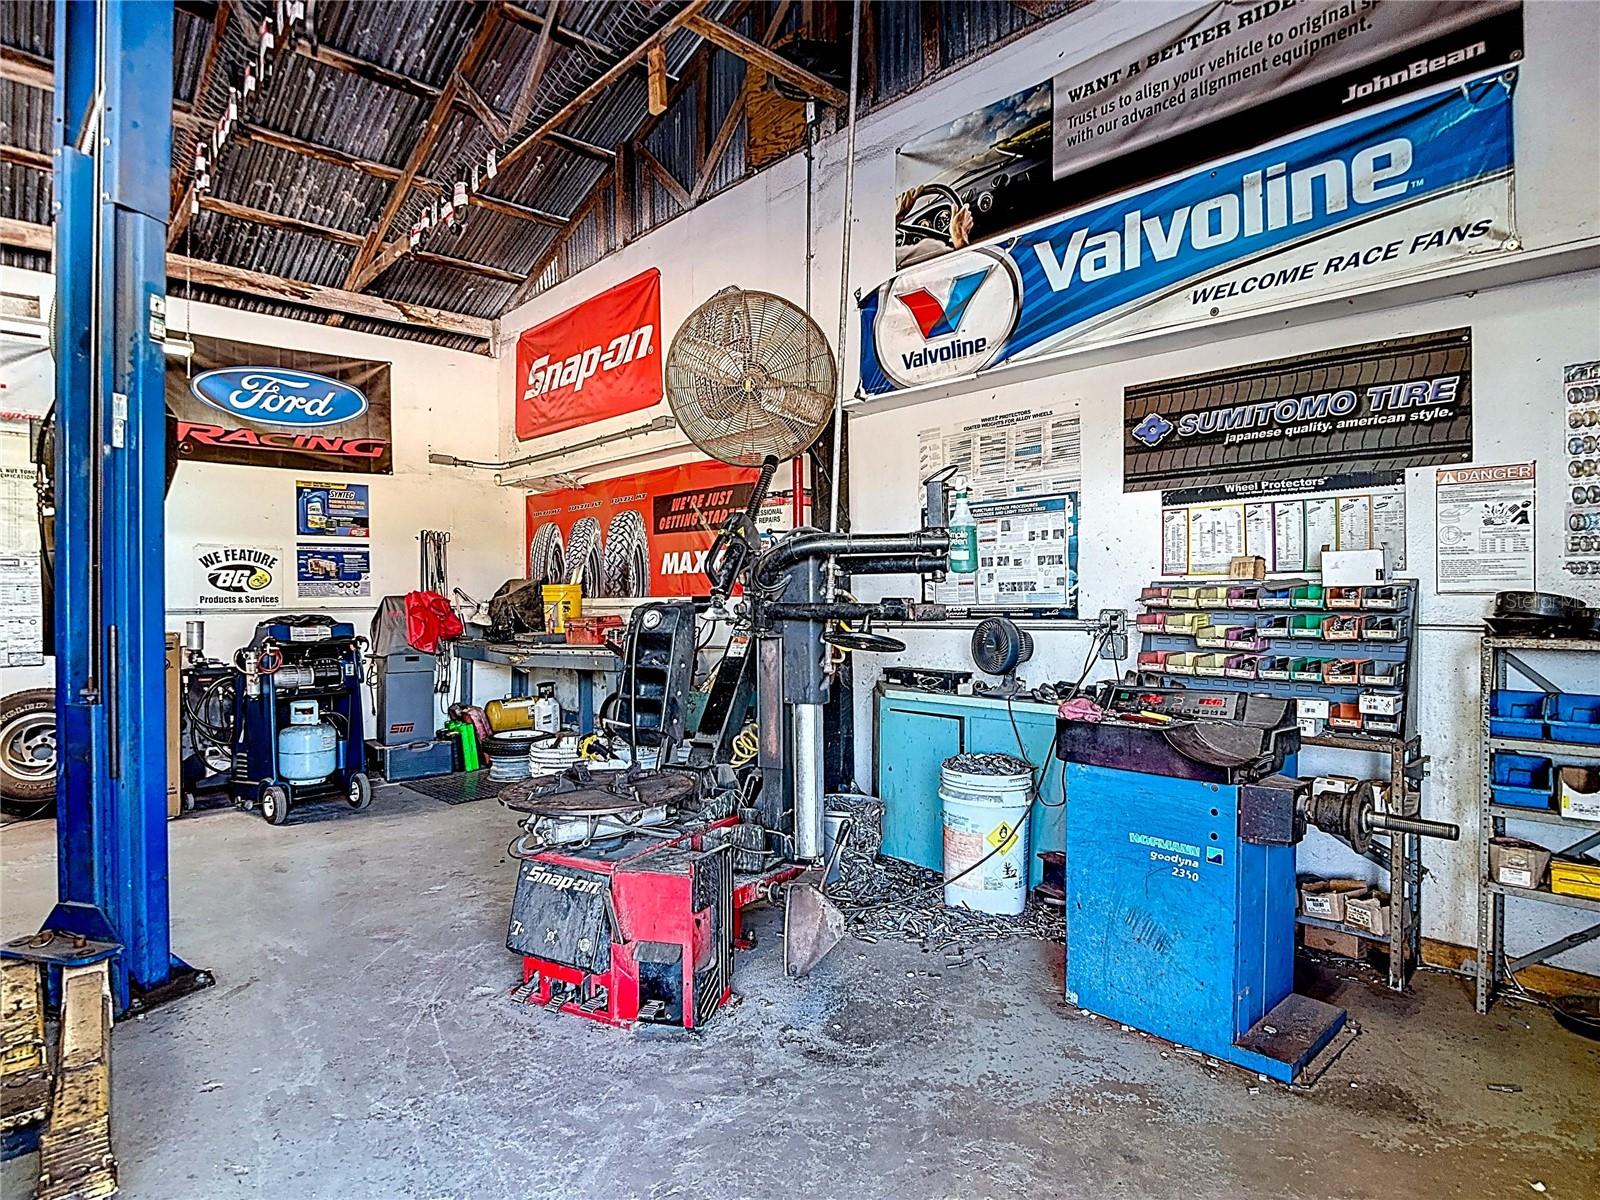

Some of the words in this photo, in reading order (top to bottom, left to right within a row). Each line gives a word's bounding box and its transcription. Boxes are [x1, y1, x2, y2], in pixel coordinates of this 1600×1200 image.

[1067, 70, 1123, 103] WANT
[1126, 60, 1141, 79] A
[1146, 20, 1232, 69] BETTER
[1067, 107, 1098, 129] Trust
[1100, 102, 1116, 116] us
[1119, 93, 1131, 108] to
[1135, 78, 1170, 101] align
[1173, 63, 1205, 90] your
[1208, 40, 1263, 72] vehicle
[1267, 32, 1283, 49] to
[1288, 0, 1358, 40] original
[1342, 40, 1488, 104] JohnBean
[1066, 126, 1094, 147] with
[1096, 117, 1119, 136] our
[1121, 91, 1186, 127] advanced
[1189, 56, 1269, 100] alignment
[1272, 17, 1373, 72] equipment.
[1033, 136, 1413, 293] Valvoline
[1192, 261, 1315, 306] WELCOME
[1322, 238, 1406, 277] RACE
[1409, 217, 1494, 256] FANS
[523, 324, 654, 401] Snap-on
[901, 337, 990, 371] Valvoline
[228, 374, 337, 417] Ford
[1178, 390, 1358, 437] SUMITOMO
[1366, 376, 1460, 412] TIRE
[1032, 410, 1054, 419] WHEELS
[1224, 427, 1282, 446] japanese
[1284, 421, 1333, 439] quality.
[1335, 413, 1408, 431] american
[1409, 407, 1454, 425] style.
[177, 421, 387, 458] RACING
[1224, 482, 1258, 493] Wheel
[1261, 478, 1326, 490] Protectors
[1457, 466, 1532, 482] DANGER
[329, 490, 355, 500] SYNTEC
[671, 493, 705, 512] WE'RE
[705, 490, 734, 507] JUST
[659, 512, 699, 531] GETTING
[758, 515, 781, 524] REPAIRS
[198, 551, 223, 569] WE
[223, 548, 278, 569] FEATURE
[216, 569, 252, 588] BG
[199, 595, 237, 604] Products
[237, 596, 244, 604] &
[244, 595, 280, 604] Services
[525, 865, 602, 895] Snap-on
[1171, 866, 1199, 882] 2350
